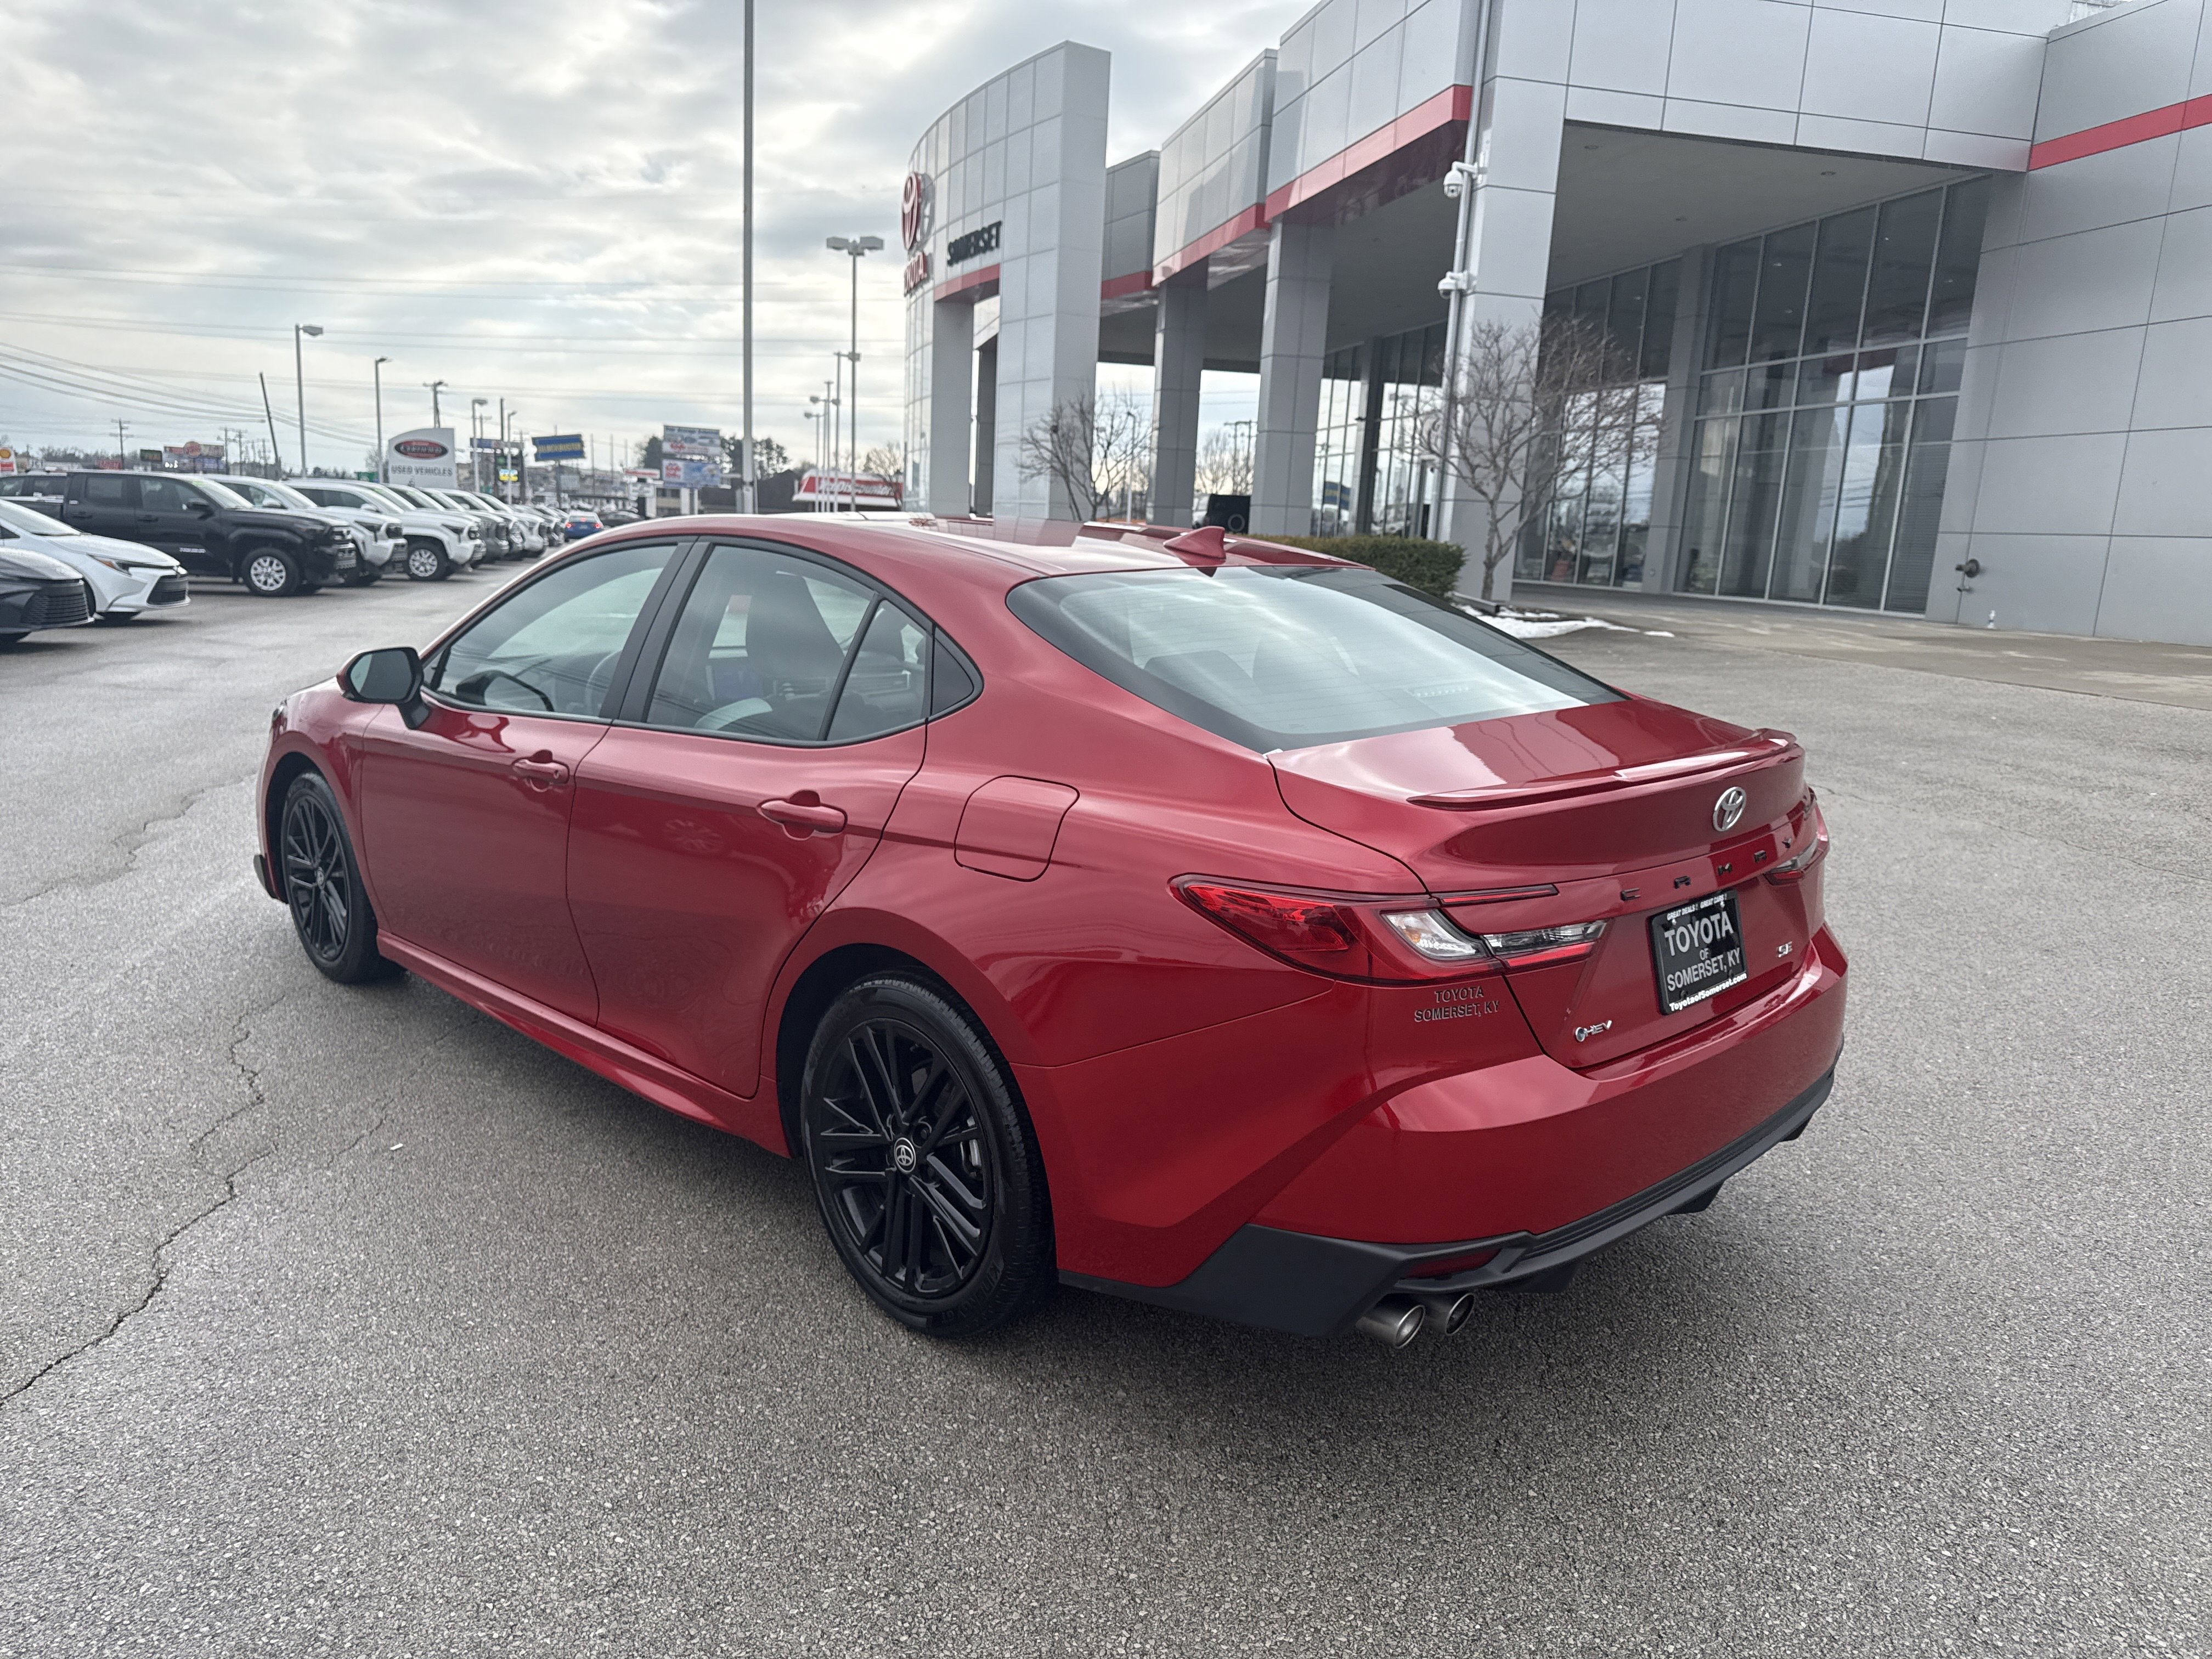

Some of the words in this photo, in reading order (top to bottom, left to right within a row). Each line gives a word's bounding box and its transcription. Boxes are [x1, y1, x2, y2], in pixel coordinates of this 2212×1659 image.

[947, 221, 1002, 267] SOMERSET
[391, 465, 413, 475] USED
[414, 466, 453, 477] VEHICLES
[1620, 837, 1792, 901] CAMRY
[1667, 910, 1681, 921] GREAT
[1700, 898, 1714, 909] GREAT
[1664, 911, 1734, 957] TOYOTA
[1700, 947, 1709, 960] OF
[1778, 941, 1793, 958] SE
[1667, 955, 1727, 991] SOMERSET,
[1727, 947, 1740, 967] KY
[1434, 985, 1484, 1003] TOYOTA
[1669, 973, 1747, 1012] ToyotaofSomerset.com
[1414, 1003, 1481, 1023] SOMERSET,
[1484, 1000, 1499, 1014] KY
